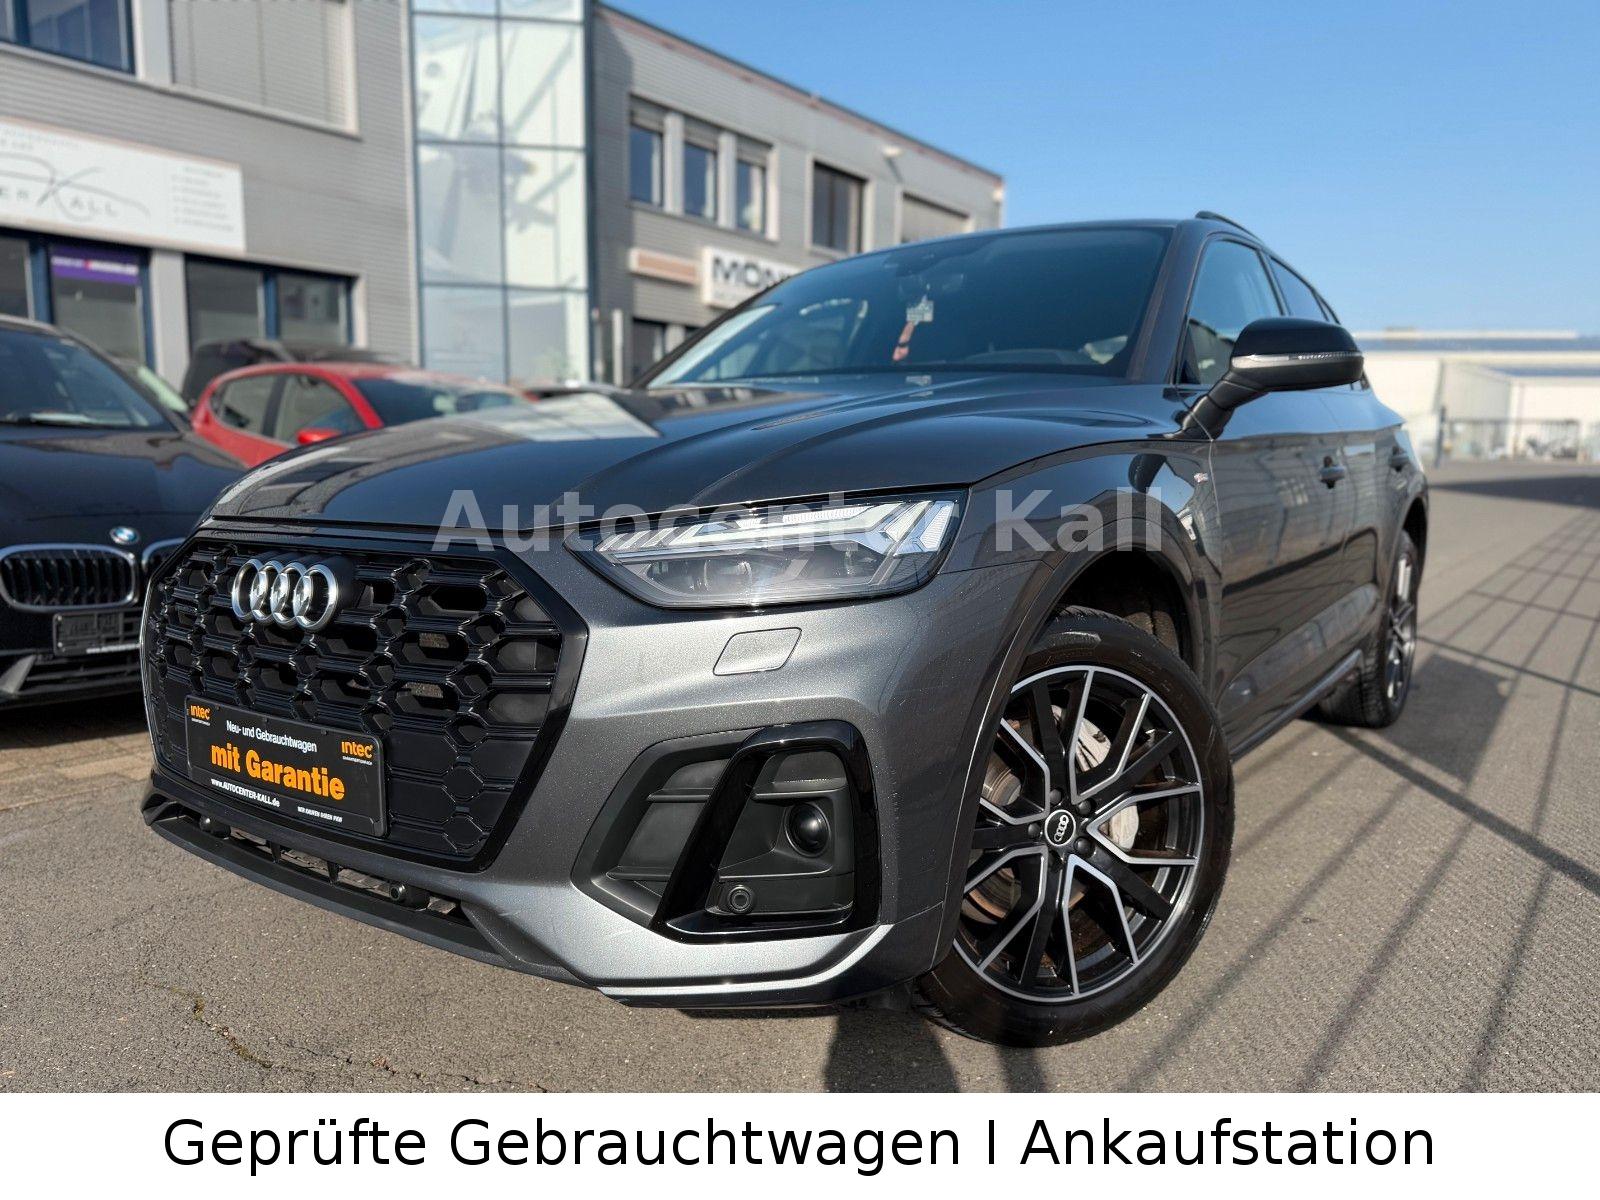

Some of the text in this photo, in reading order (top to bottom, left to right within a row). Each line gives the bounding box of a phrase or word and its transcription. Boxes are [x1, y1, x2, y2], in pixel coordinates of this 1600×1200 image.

[226, 720, 242, 734] Neu-
[242, 726, 255, 738] und
[255, 727, 318, 753] Gebrauchtwagen
[211, 742, 345, 801] mit Garantie
